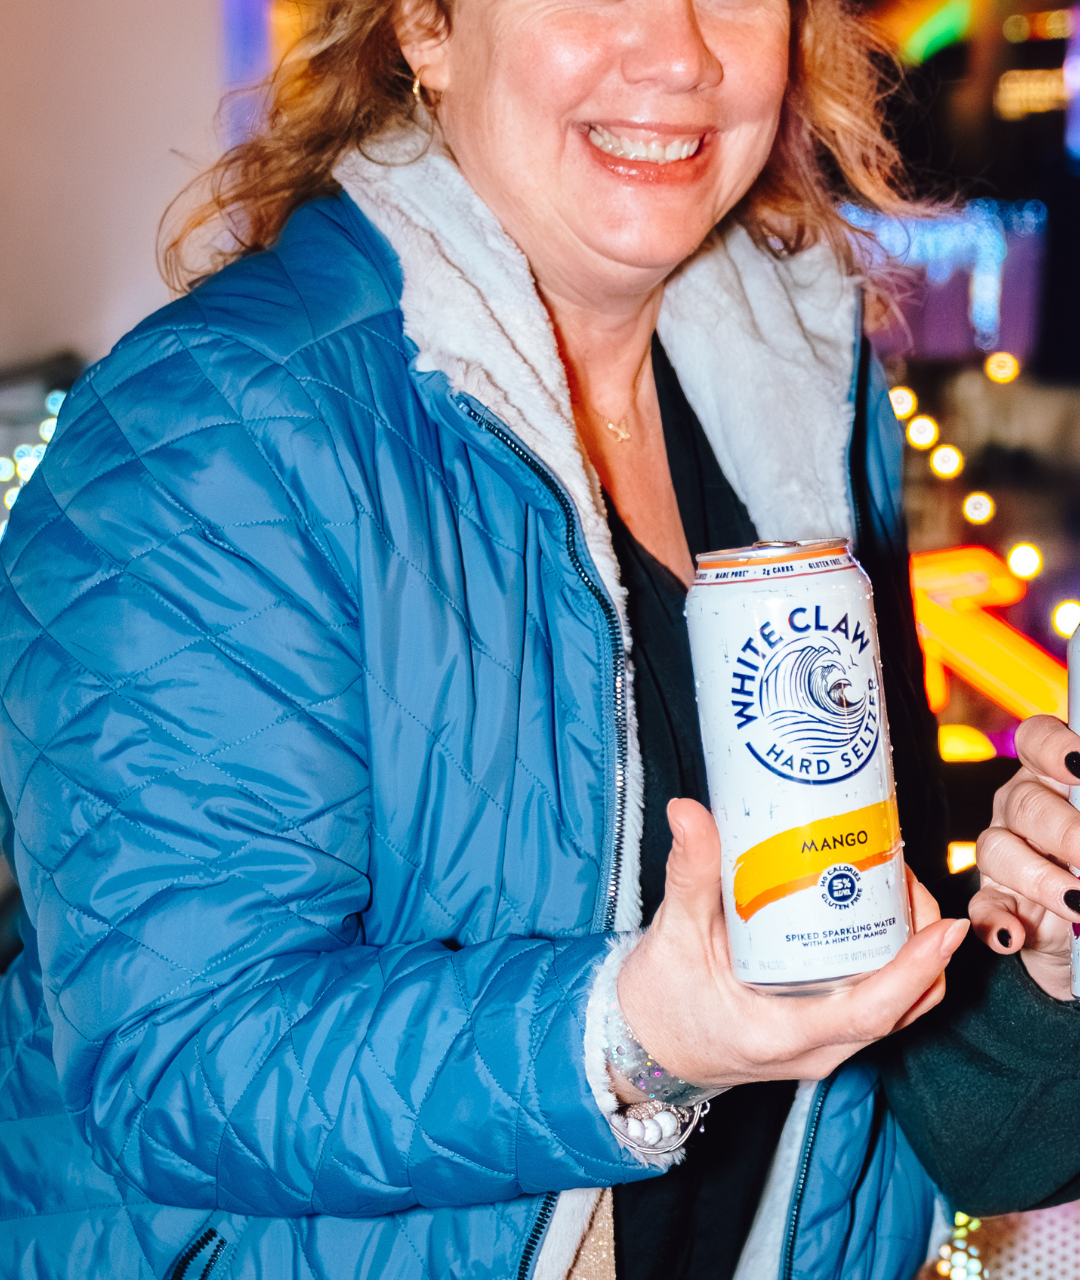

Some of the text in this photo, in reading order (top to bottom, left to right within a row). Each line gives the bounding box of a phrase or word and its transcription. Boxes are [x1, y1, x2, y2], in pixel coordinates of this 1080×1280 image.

[772, 565, 794, 574] CARBS
[808, 560, 830, 570] GLUTEN
[830, 558, 843, 567] FREE
[731, 605, 871, 730] WHITE CLAW
[765, 678, 878, 776] HARD SELTZER
[801, 830, 869, 854] MANGO
[820, 865, 862, 888] 140 CALORIES
[832, 877, 852, 891] 5%
[821, 888, 863, 911] GLUTEN FREE
[785, 916, 897, 943] SPIKED SPARKLING WATER
[801, 939, 823, 948] WITH
[832, 936, 850, 945] HINT
[851, 933, 861, 942] OF
[863, 928, 888, 939] MANGO
[850, 949, 867, 963] WITH
